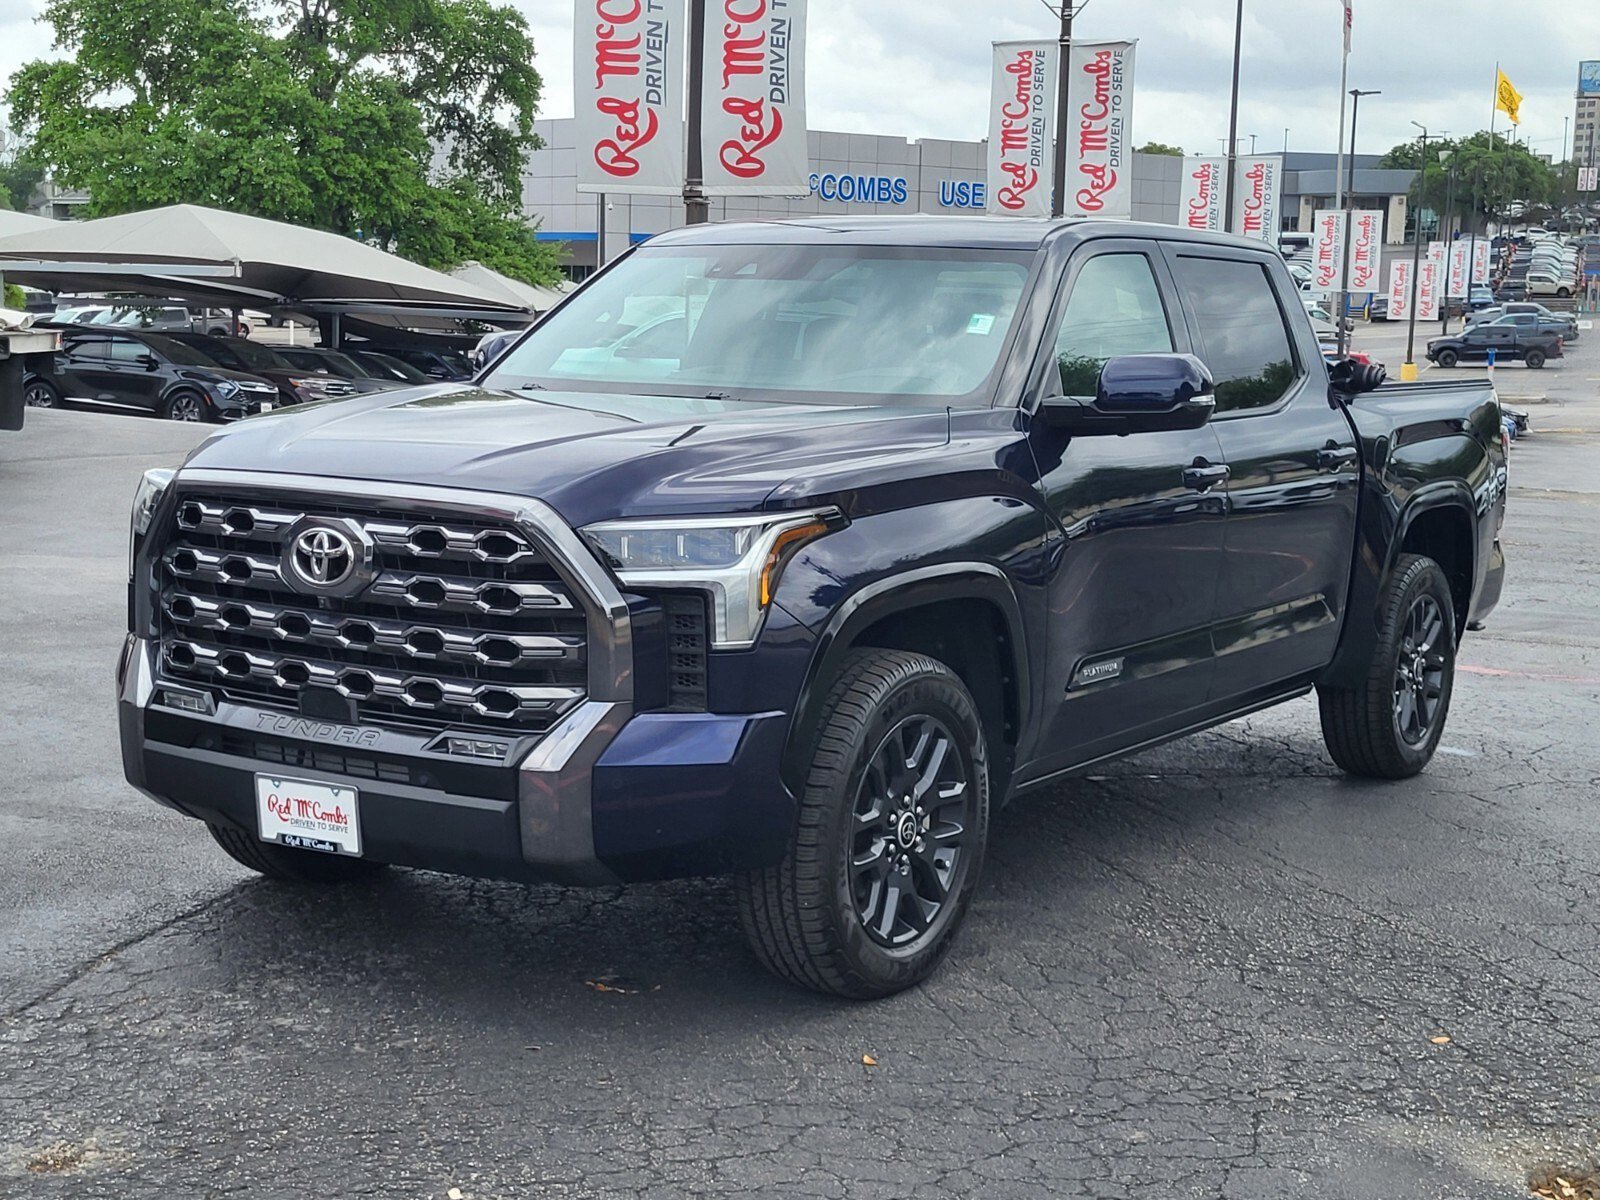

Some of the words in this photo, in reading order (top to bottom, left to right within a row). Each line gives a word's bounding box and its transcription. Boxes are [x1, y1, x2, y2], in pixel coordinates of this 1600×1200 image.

[646, 20, 664, 105] DRIVEN
[769, 18, 787, 104] DRIVEN
[1034, 50, 1046, 91] SERVE
[1112, 50, 1123, 91] SERVE
[1001, 50, 1033, 158] McCombs
[1033, 94, 1044, 113] TO
[1079, 50, 1112, 159] McCombs
[1112, 94, 1122, 113] TO
[594, 97, 658, 177] Red
[719, 97, 783, 178] Red
[1030, 117, 1042, 167] DRIVEN
[1110, 117, 1121, 168] DRIVEN
[998, 162, 1038, 210] Red
[1076, 163, 1117, 211] Red
[1210, 193, 1218, 205] TO
[1211, 163, 1220, 191] SERVE
[1243, 163, 1265, 235] McCombs
[1264, 163, 1273, 191] SERVE
[1264, 193, 1272, 205] TO
[1319, 215, 1335, 263] McCombs
[1355, 215, 1371, 264] McCombs
[1317, 265, 1336, 287] Red
[1353, 265, 1373, 287] Red
[257, 713, 380, 746] TUNDRA
[268, 793, 292, 822] Red
[293, 798, 348, 825] McCombs
[291, 818, 315, 829] DRIVEN
[317, 822, 326, 830] TO
[328, 824, 348, 833] SERVE
